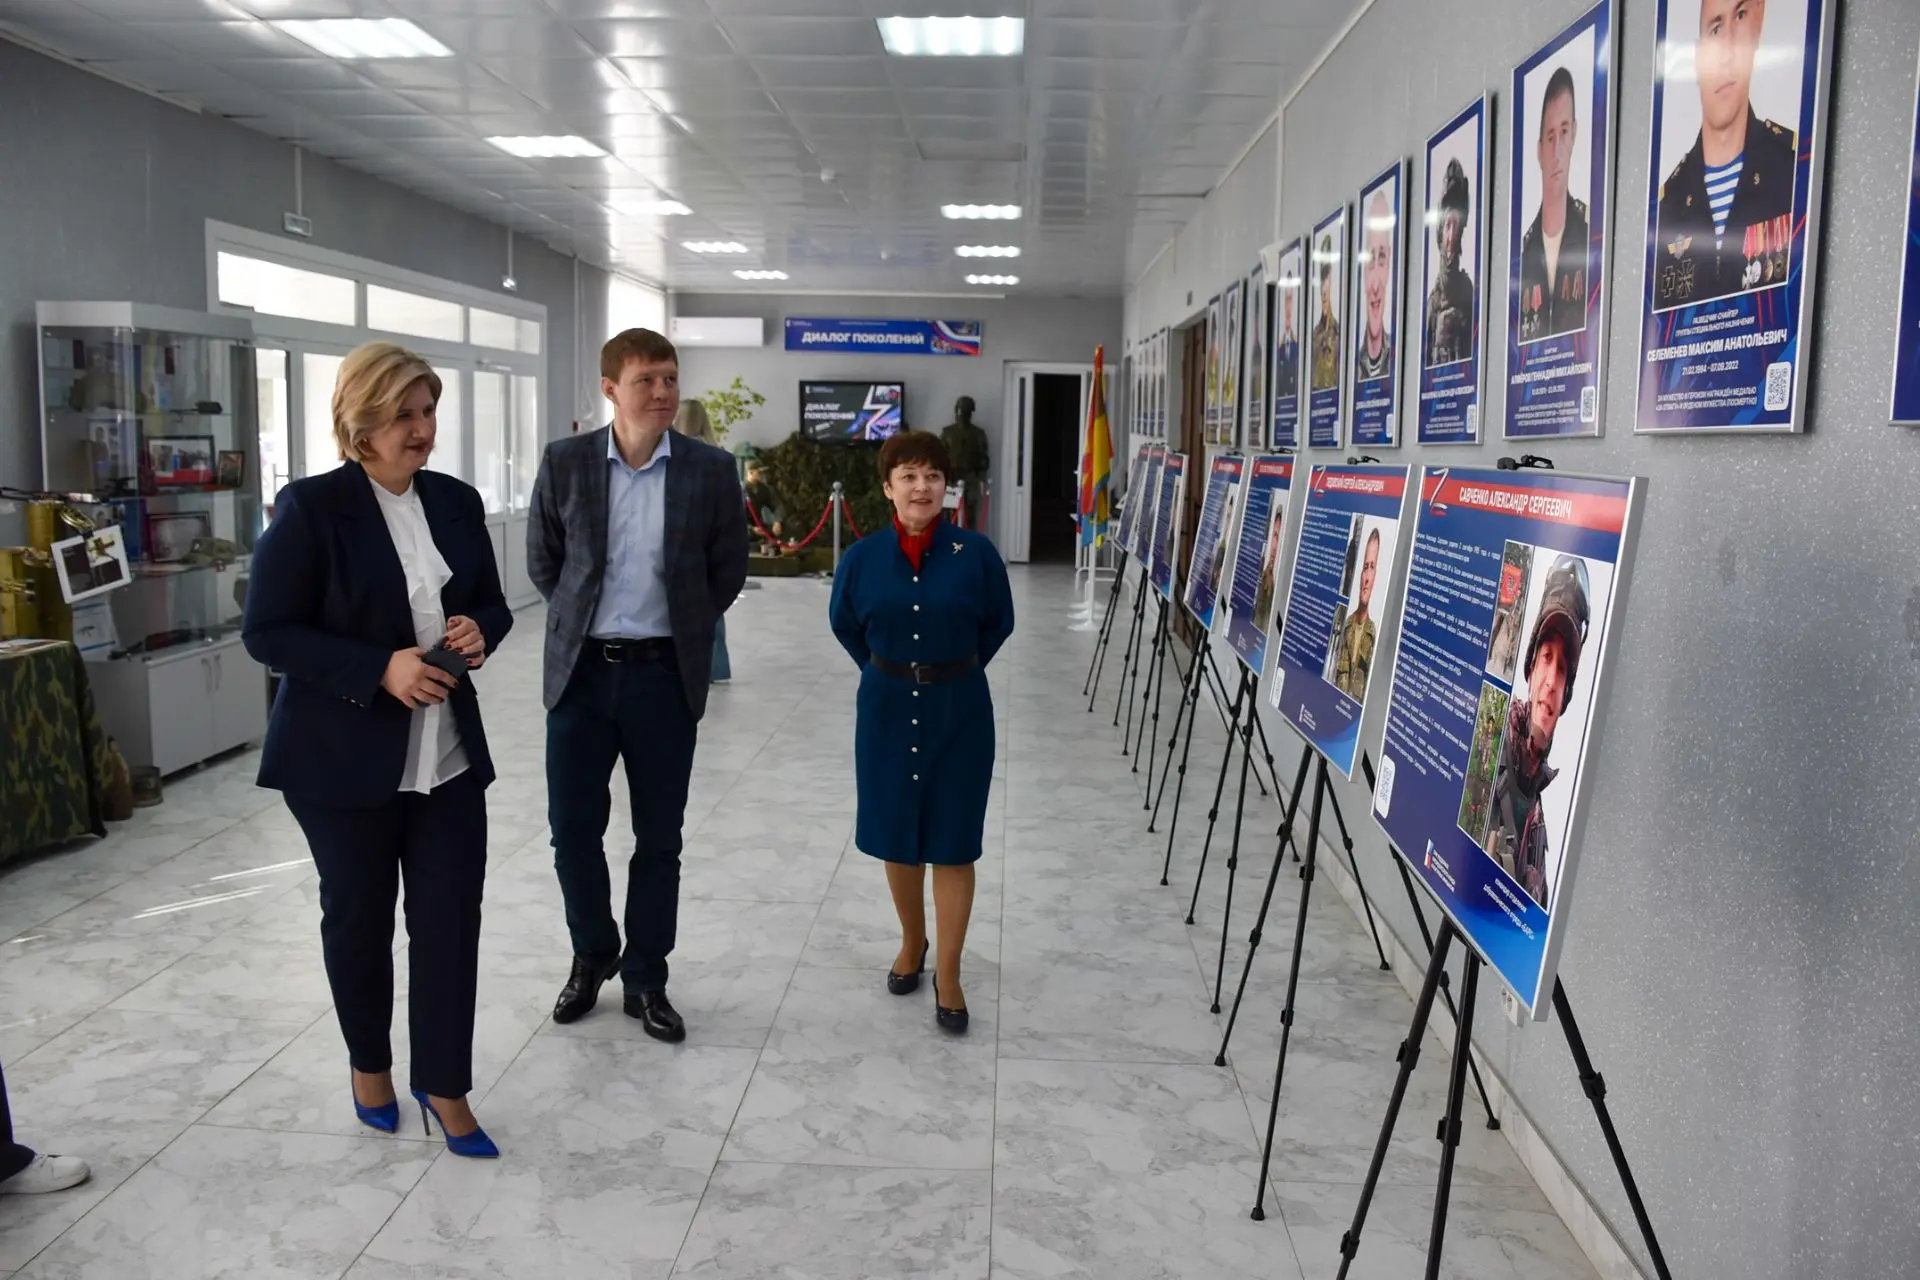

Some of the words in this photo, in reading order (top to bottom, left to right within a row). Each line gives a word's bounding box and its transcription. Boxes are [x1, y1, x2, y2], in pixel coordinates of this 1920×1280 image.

[801, 332, 852, 344] ДИАЛОГ
[852, 332, 924, 345] ПОКОЛЕНИЙ
[1647, 345, 1687, 362] СЕЛЕМЕНЕВ
[1688, 338, 1724, 356] МАКСИМ
[1724, 328, 1788, 351] АНАТОЛЬЕВИЧ
[804, 403, 841, 411] ДИАЛОГ
[1459, 486, 1489, 506] САВЧЕНКО
[1488, 490, 1528, 516] АЛЕКСАНДР
[1528, 495, 1572, 518] СЕРГЕЕВИЧ
